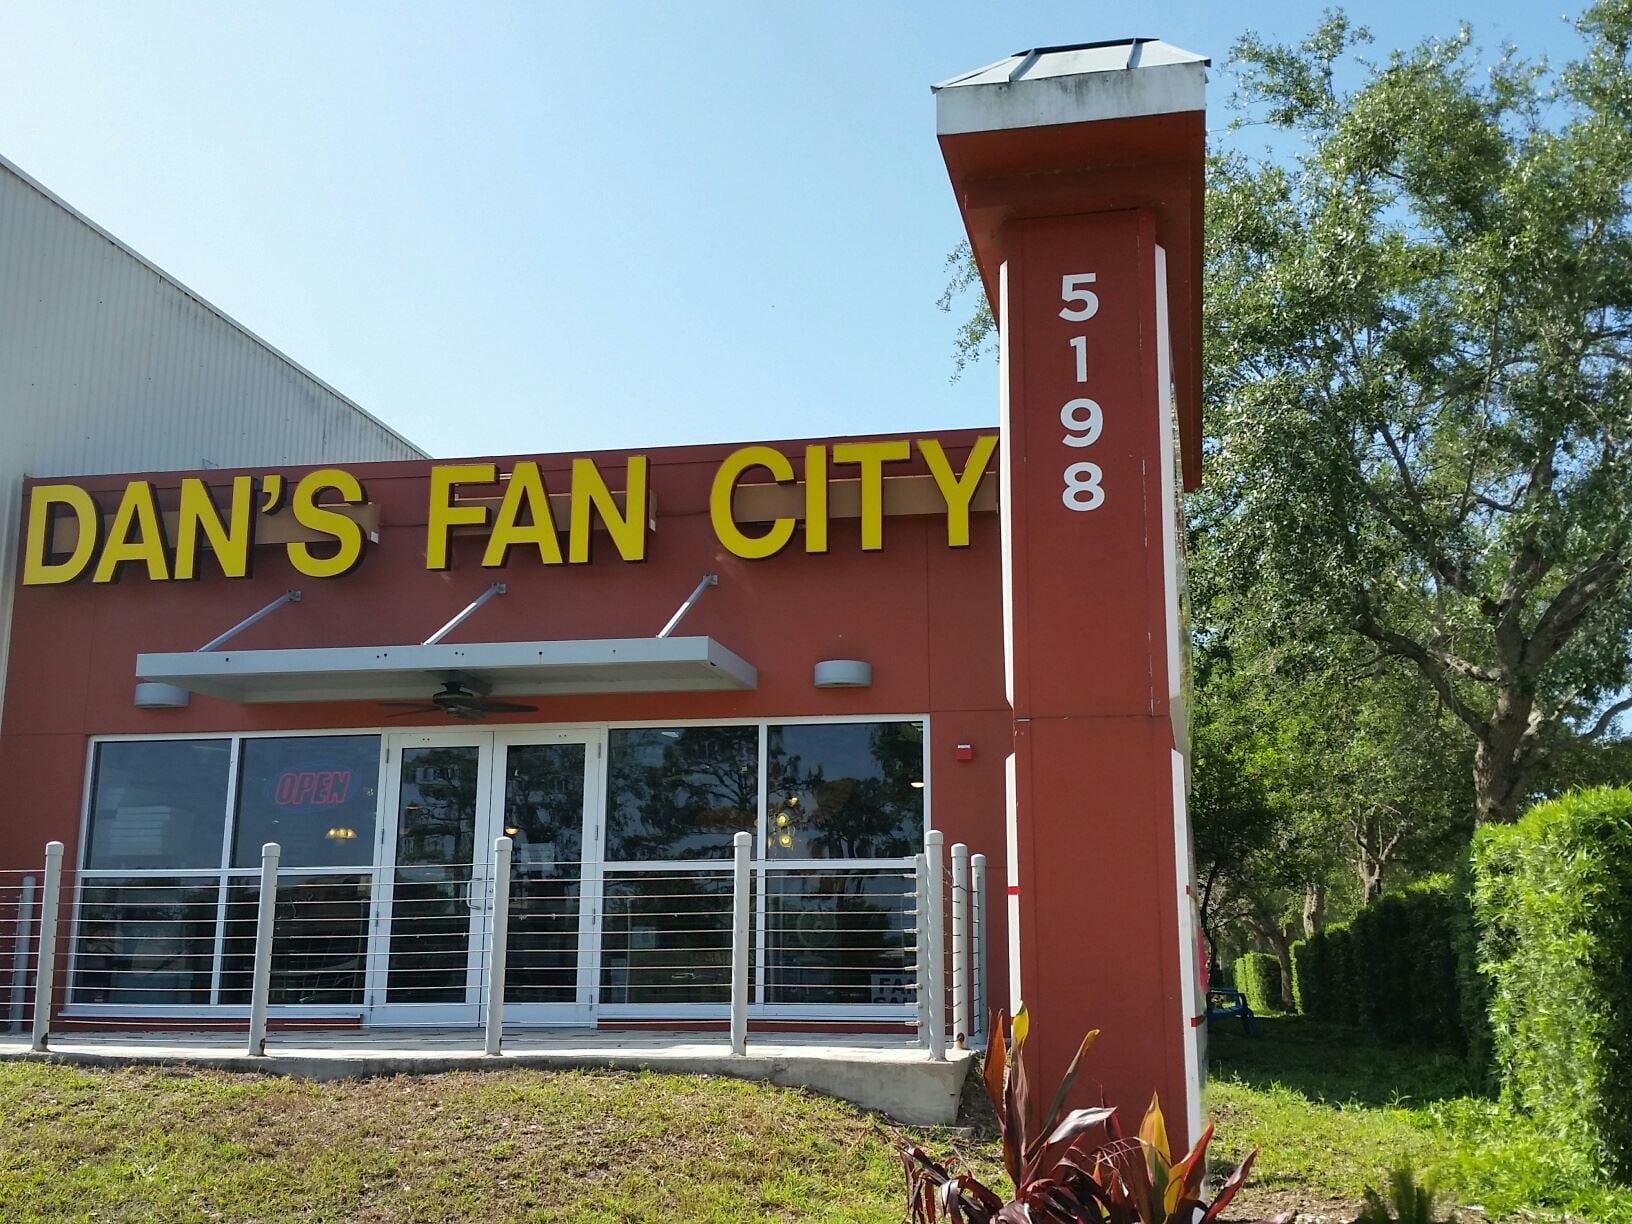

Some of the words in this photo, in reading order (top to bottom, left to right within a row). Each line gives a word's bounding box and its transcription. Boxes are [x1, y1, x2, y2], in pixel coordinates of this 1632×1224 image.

[1058, 272, 1105, 512] 5198
[23, 469, 363, 585] DAN'S
[427, 455, 650, 570] FAN
[710, 435, 999, 560] CITY
[274, 770, 352, 805] OPEN
